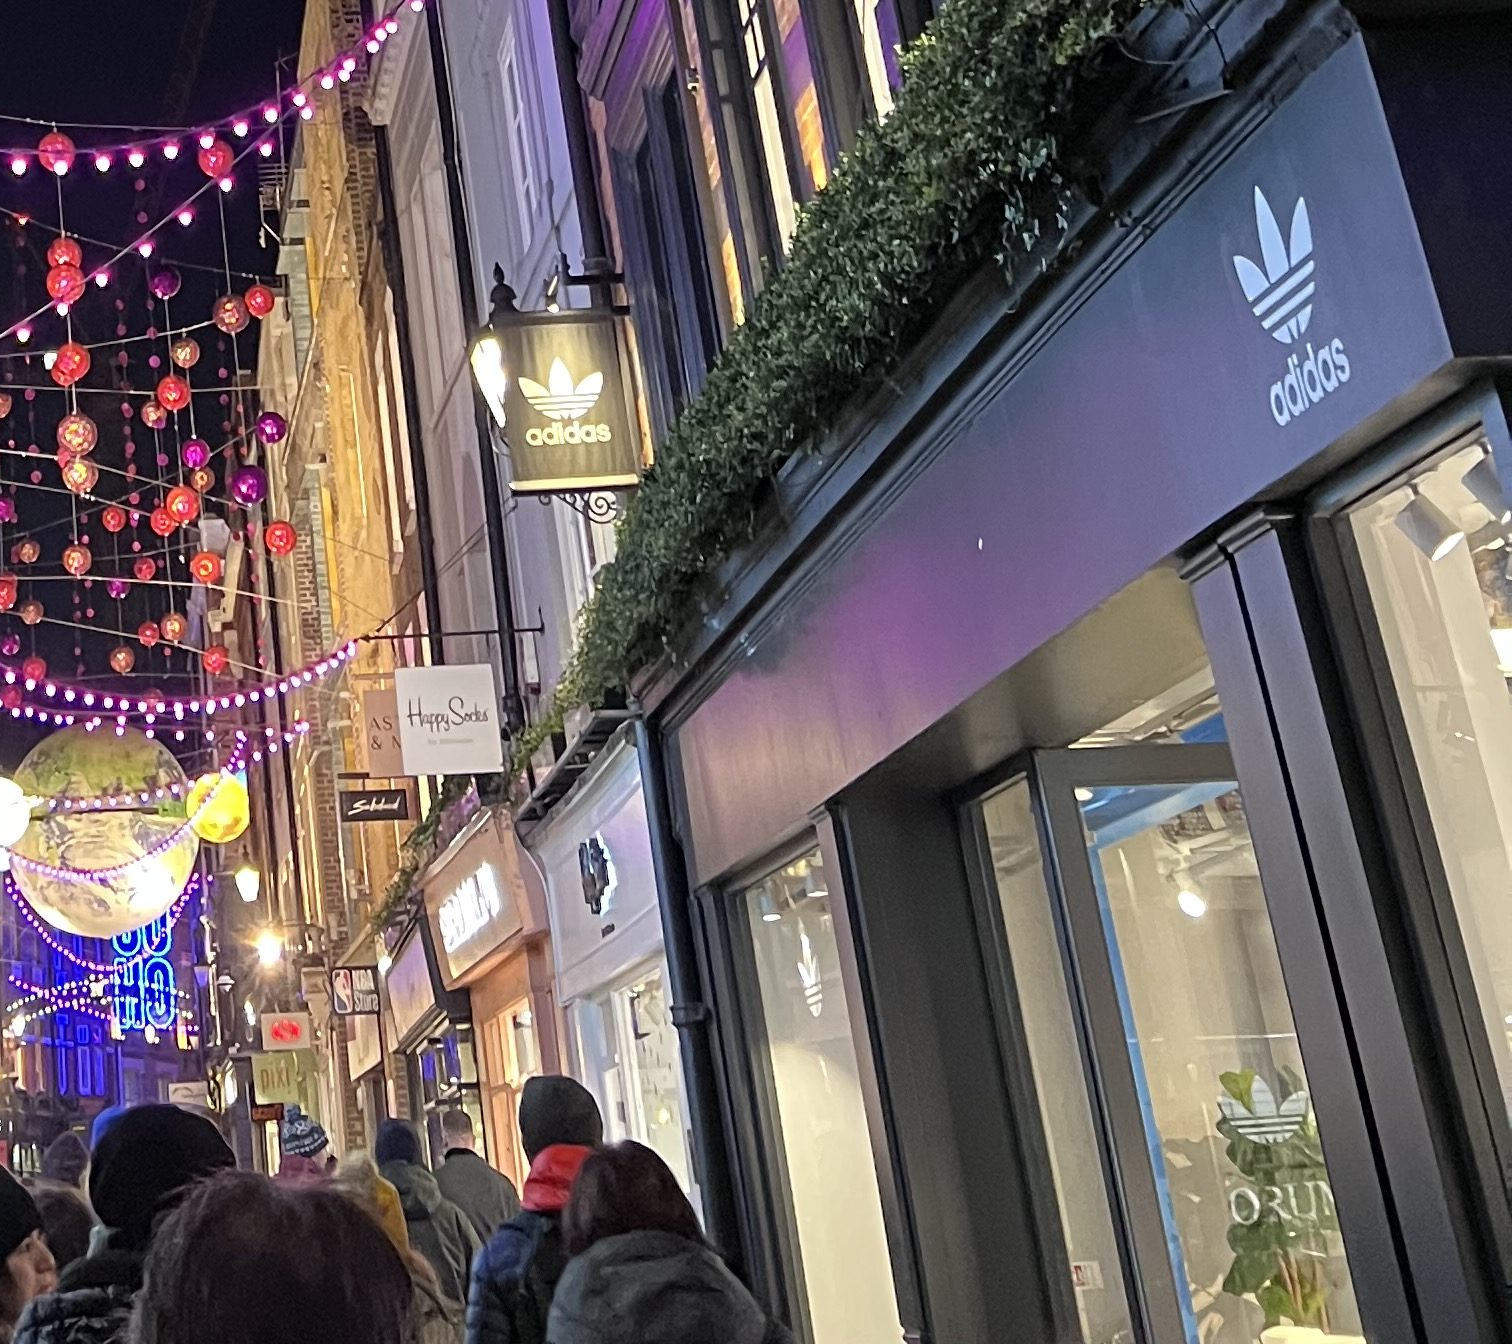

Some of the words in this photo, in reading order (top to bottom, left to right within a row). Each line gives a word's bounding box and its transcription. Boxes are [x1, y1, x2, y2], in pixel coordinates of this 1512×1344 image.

[1270, 338, 1350, 426] adidas
[526, 421, 612, 447] adidas
[407, 696, 450, 733] Happy
[449, 696, 489, 726] Socks
[352, 969, 375, 991] NBA
